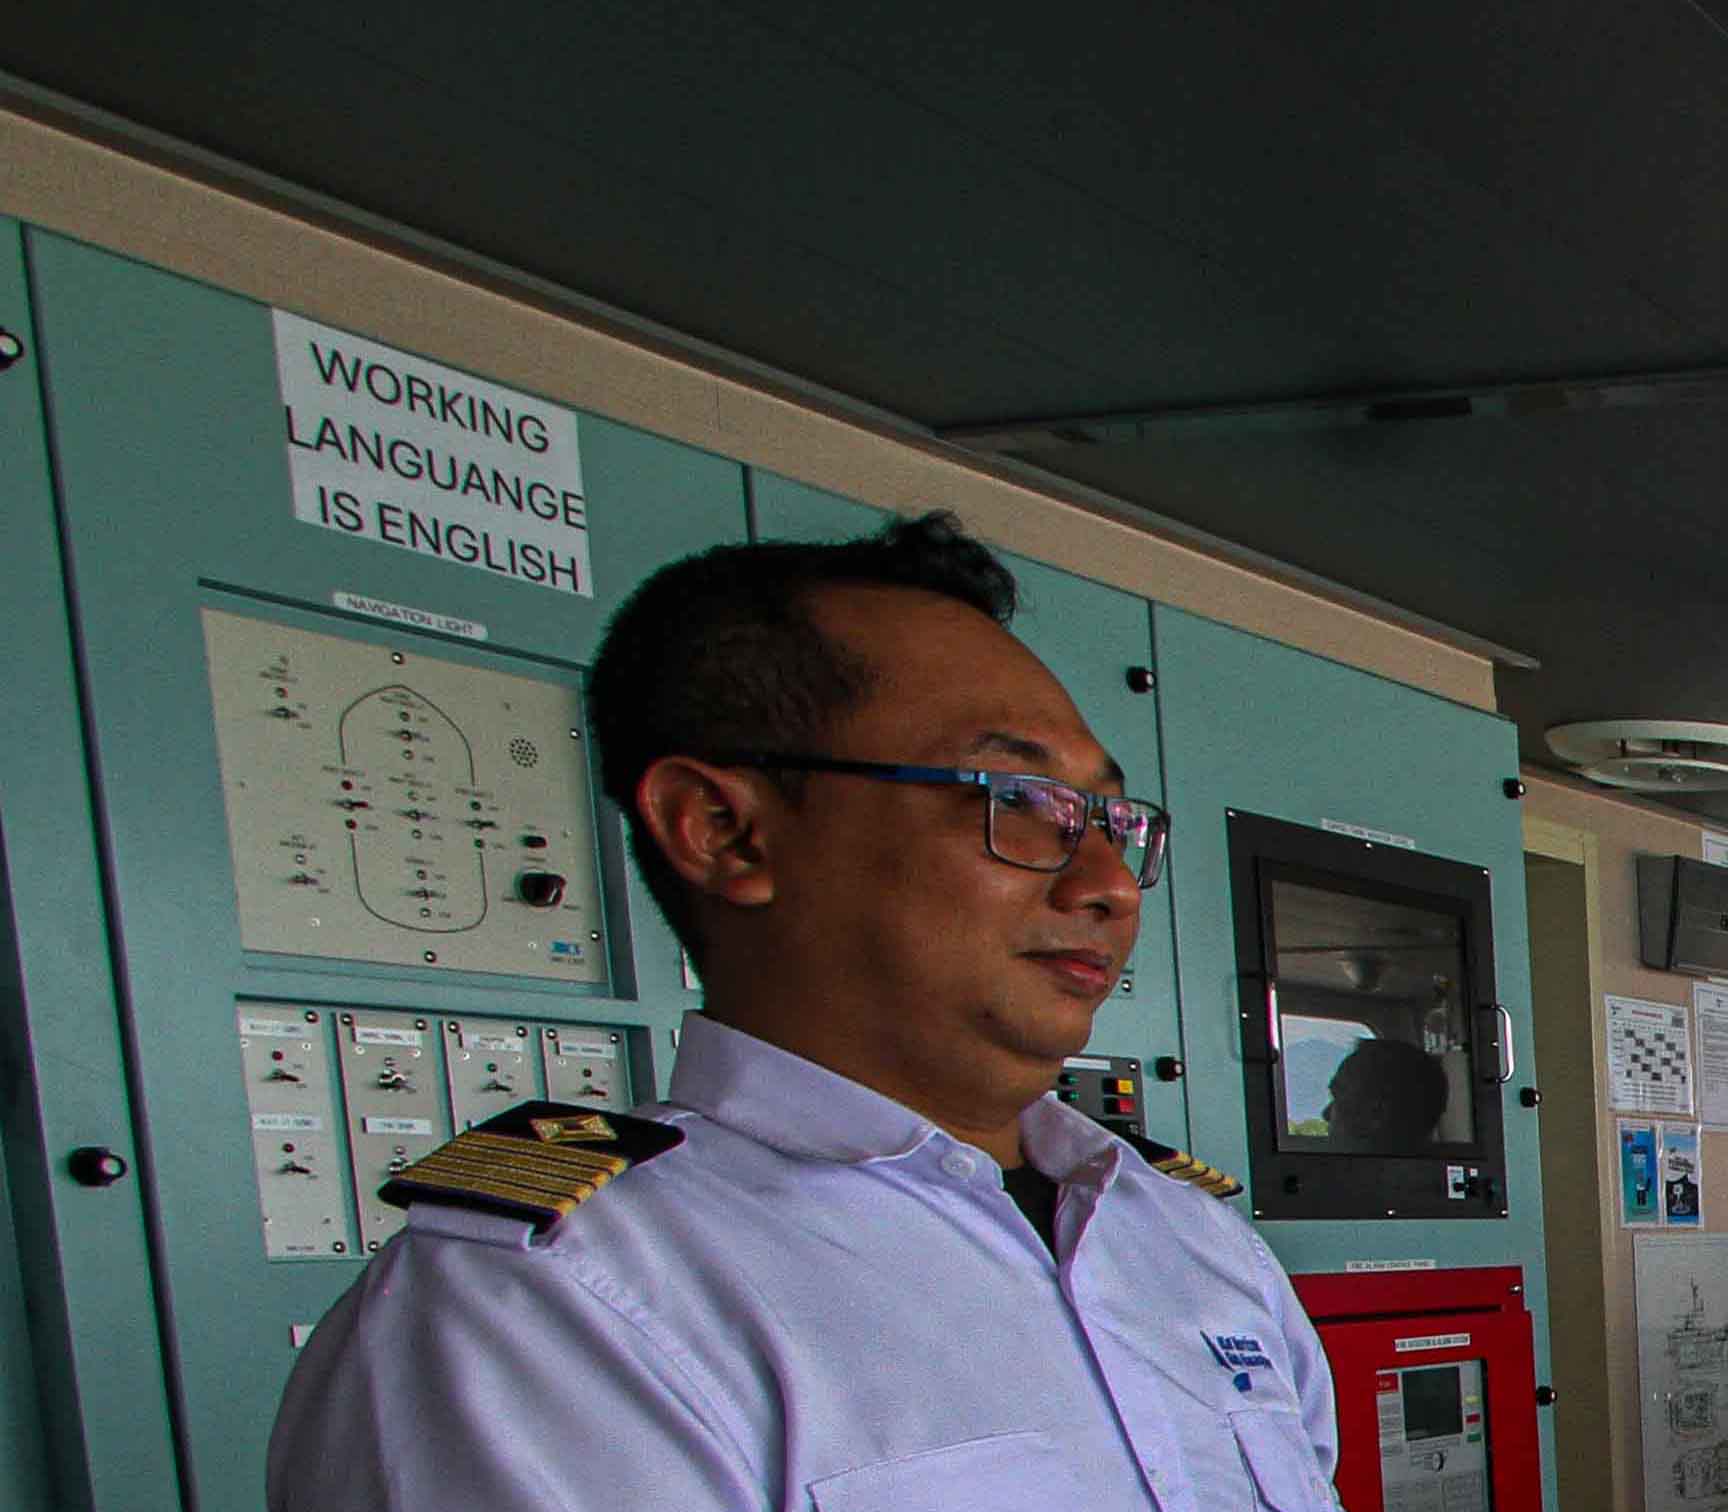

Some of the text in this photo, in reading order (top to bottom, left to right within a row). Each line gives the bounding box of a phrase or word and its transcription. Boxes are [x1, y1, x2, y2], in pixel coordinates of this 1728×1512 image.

[309, 343, 550, 455] WORKING
[285, 405, 586, 531] LANGUANGE
[320, 485, 580, 592] IS ENGLISH
[347, 597, 475, 636] NAVIGATION LIGHT
